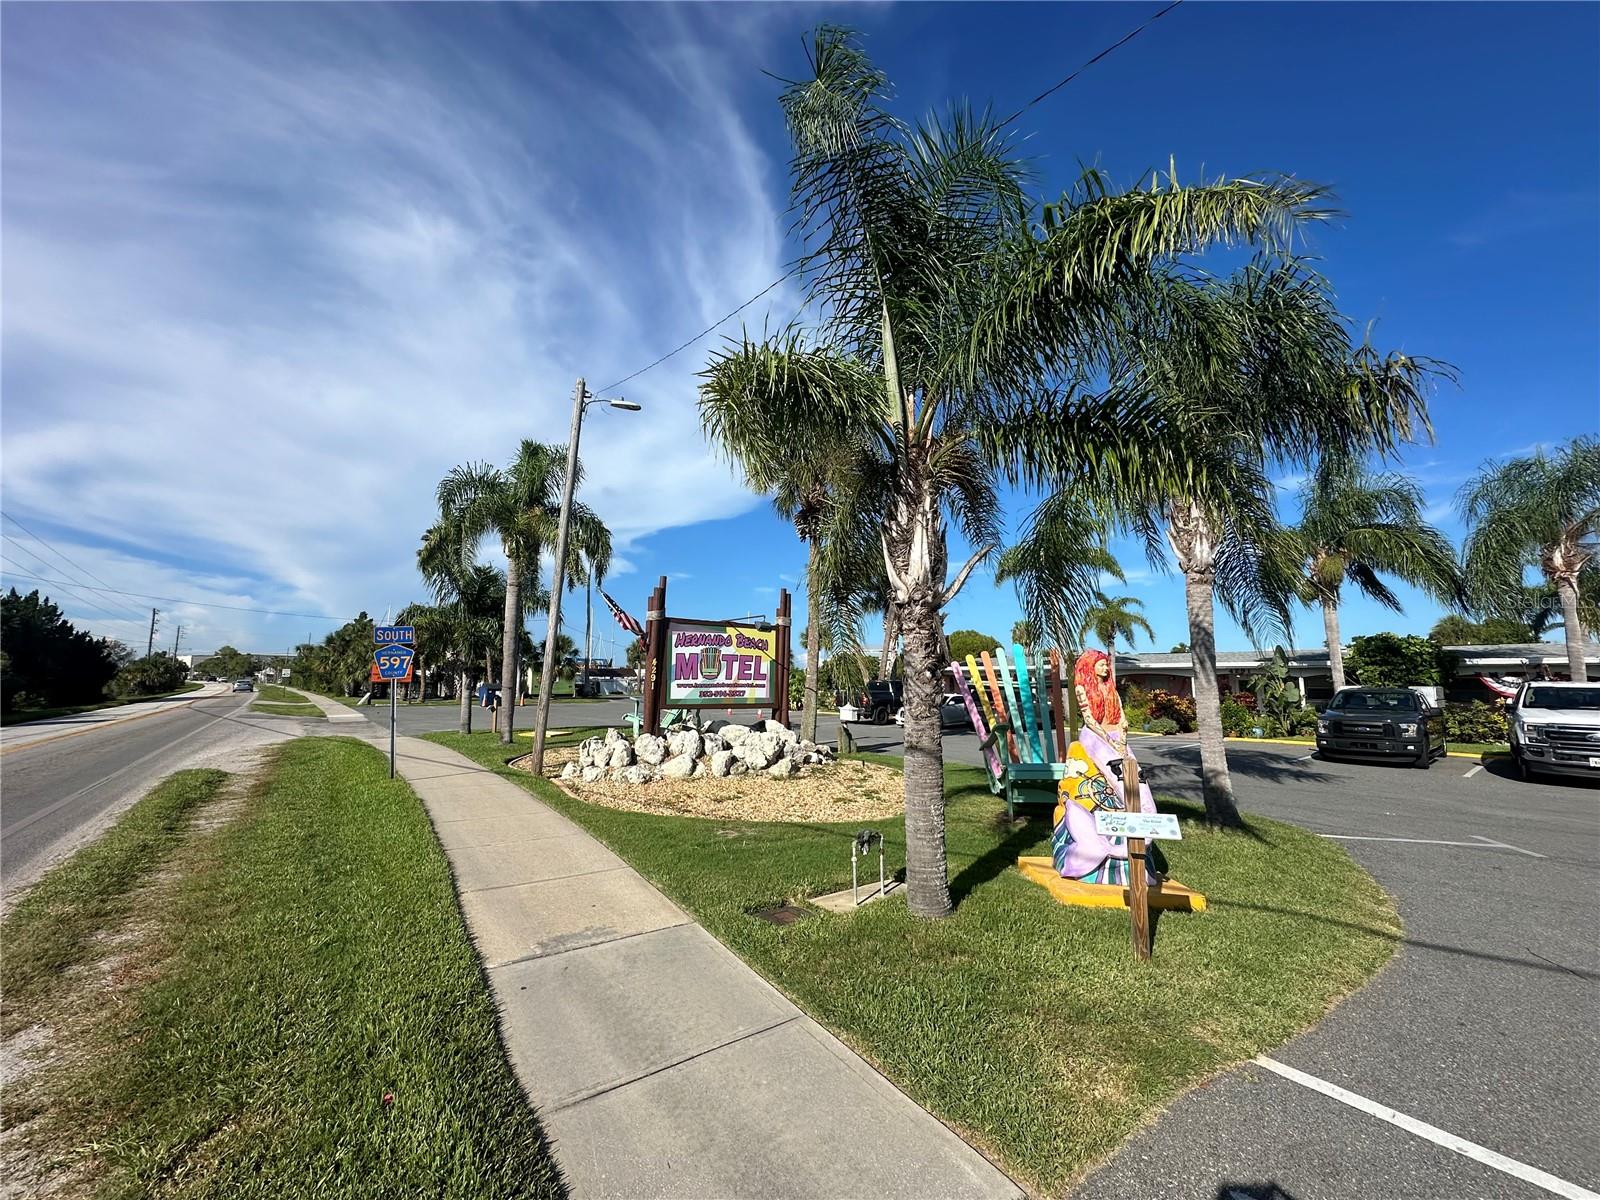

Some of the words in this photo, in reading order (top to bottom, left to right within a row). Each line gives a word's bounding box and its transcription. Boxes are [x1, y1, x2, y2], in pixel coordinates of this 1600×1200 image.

[376, 630, 412, 641] SOUTH
[675, 632, 732, 648] HERNANDO
[735, 633, 769, 650] BEACH
[380, 656, 411, 669] 597
[675, 652, 767, 681] MOTEL
